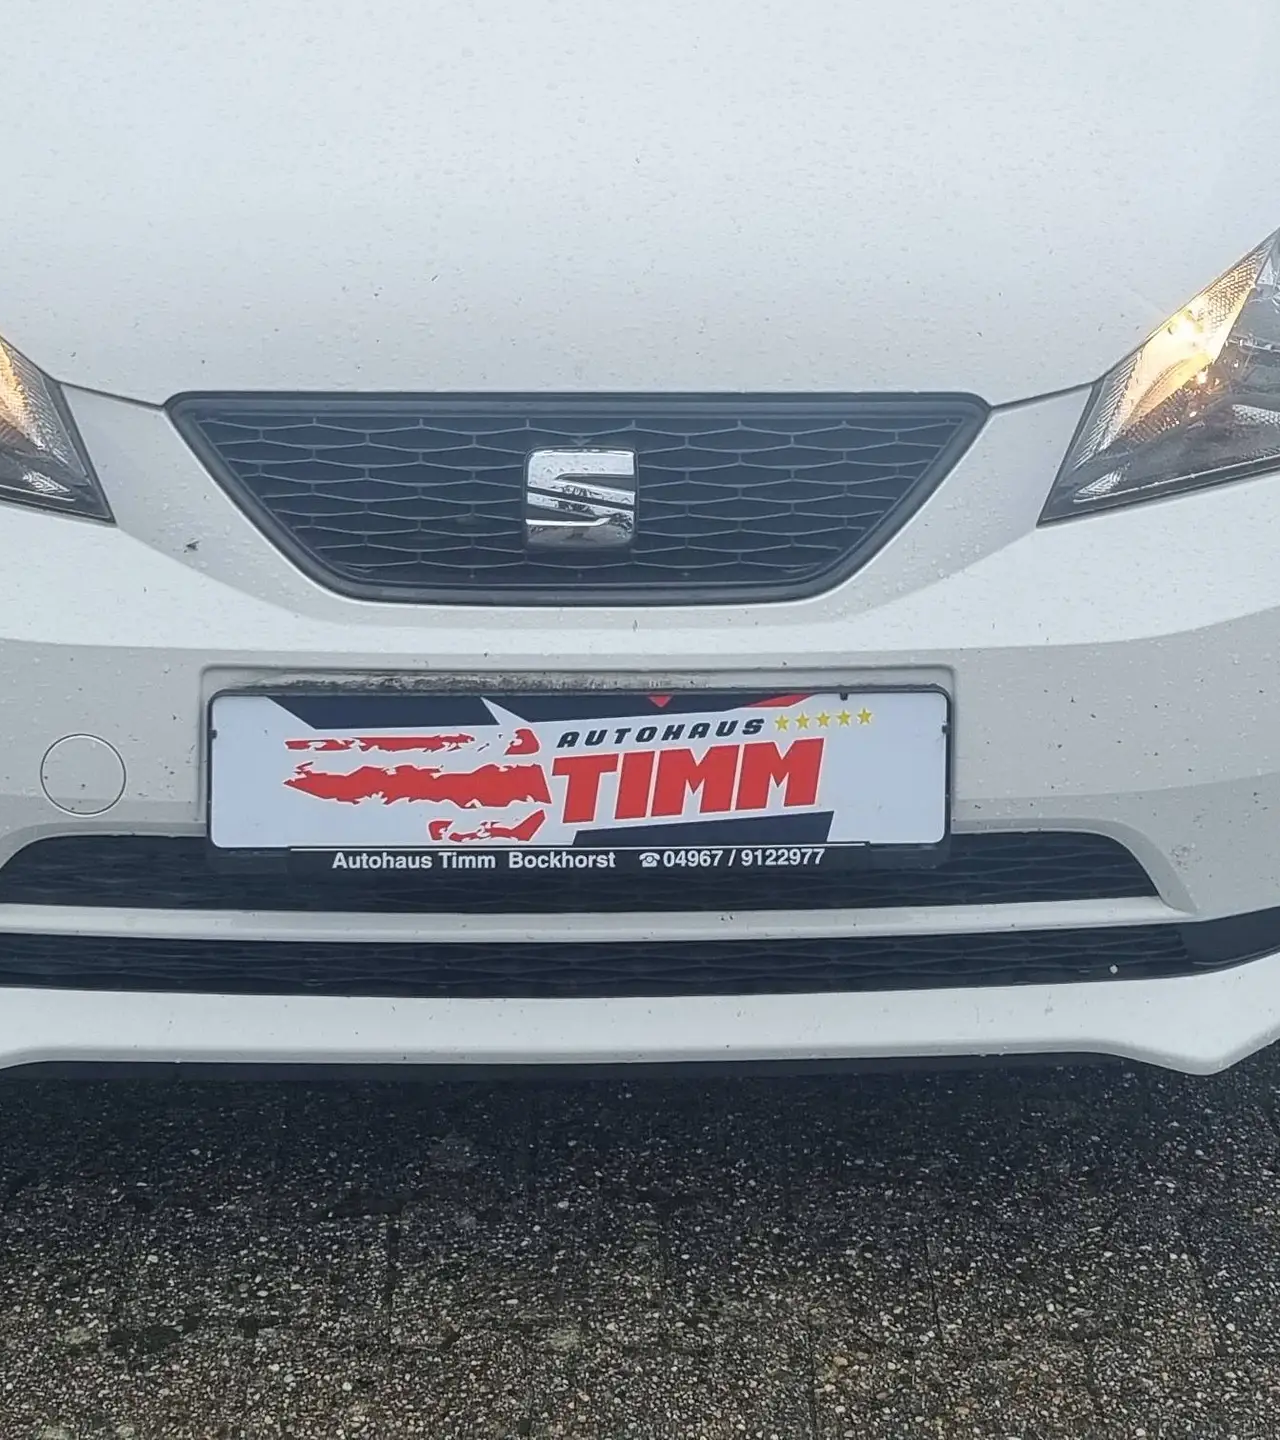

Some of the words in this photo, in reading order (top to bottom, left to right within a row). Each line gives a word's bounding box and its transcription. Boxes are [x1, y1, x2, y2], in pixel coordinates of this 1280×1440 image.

[556, 717, 766, 749] AUTOHAUS
[550, 736, 825, 824] TIMM
[331, 851, 433, 870] Autohaus
[438, 851, 496, 869] Timm
[508, 850, 617, 869] Bockhorst
[662, 850, 724, 868] 04967
[740, 848, 826, 867] 9122977
